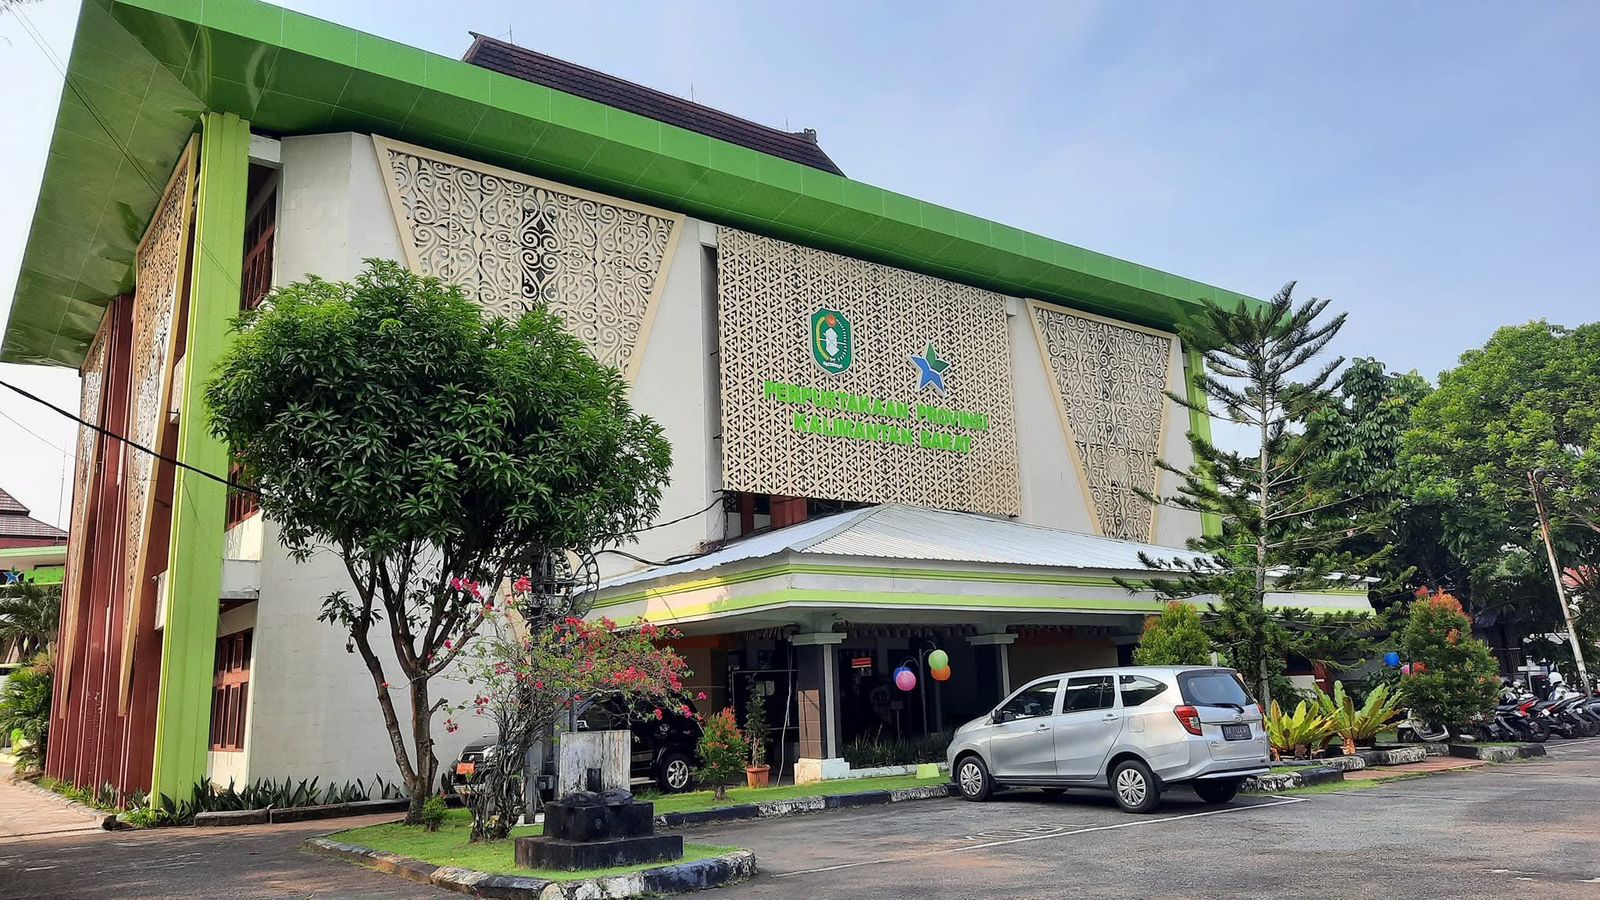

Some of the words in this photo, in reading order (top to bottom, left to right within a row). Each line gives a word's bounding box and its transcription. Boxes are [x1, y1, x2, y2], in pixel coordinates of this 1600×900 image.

[764, 380, 910, 421] PERPUSTAKAAN
[916, 403, 988, 431] PROVINSI
[792, 412, 913, 447] KALIMANTAN
[920, 429, 971, 455] BARAT
